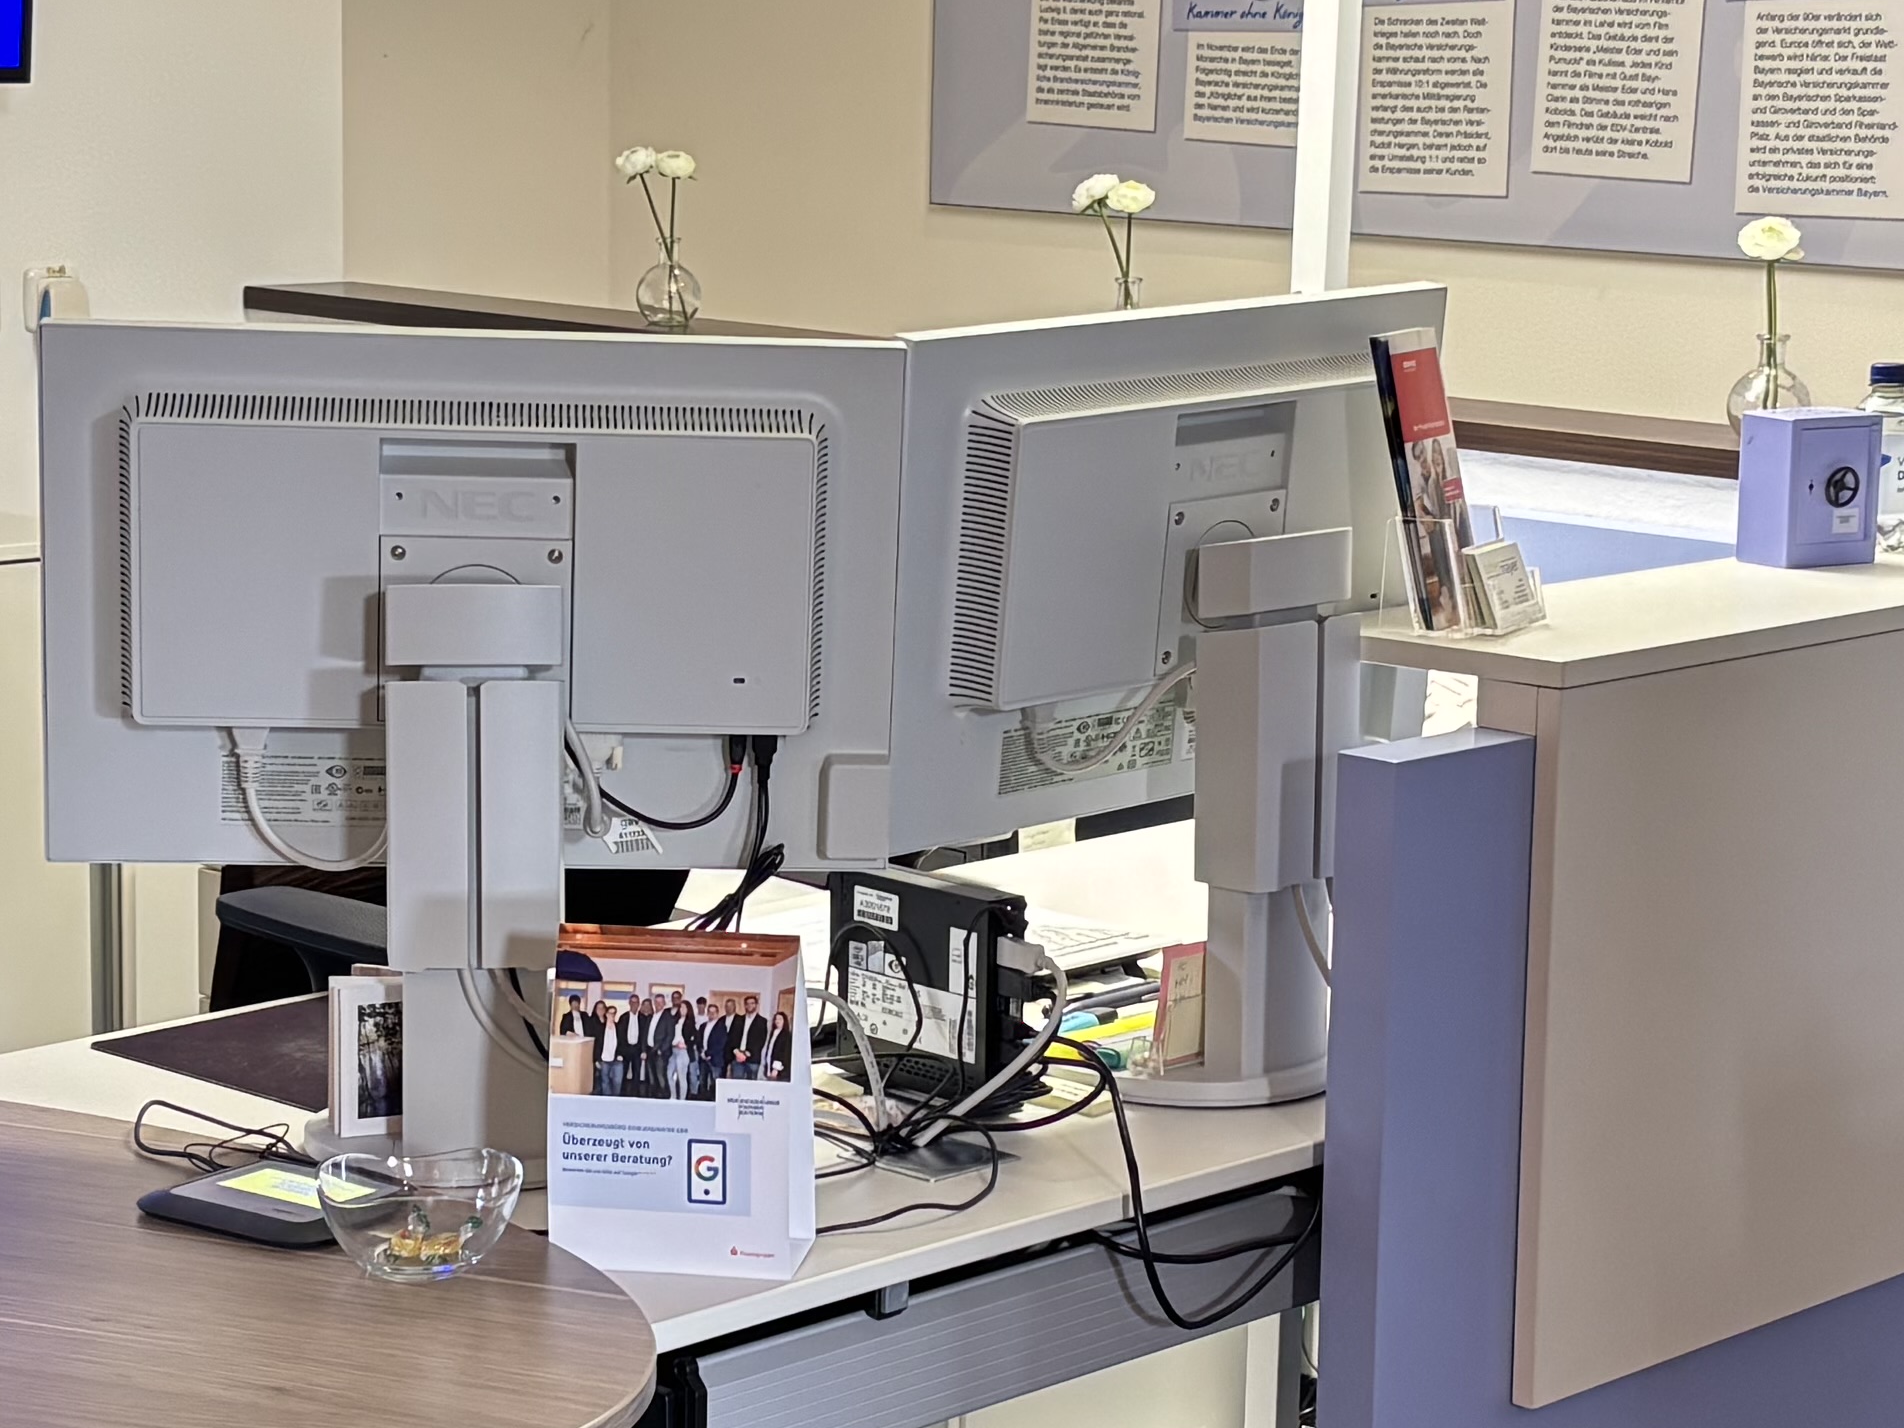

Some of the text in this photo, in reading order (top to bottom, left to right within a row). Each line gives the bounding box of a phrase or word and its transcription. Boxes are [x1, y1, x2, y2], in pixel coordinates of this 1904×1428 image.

[1187, 2, 1237, 20] Kammer
[1240, 2, 1267, 19] ohne
[418, 489, 536, 522] NEC
[562, 1131, 650, 1151] Überzeugt von
[561, 1151, 673, 1168] unserer Beratung?
